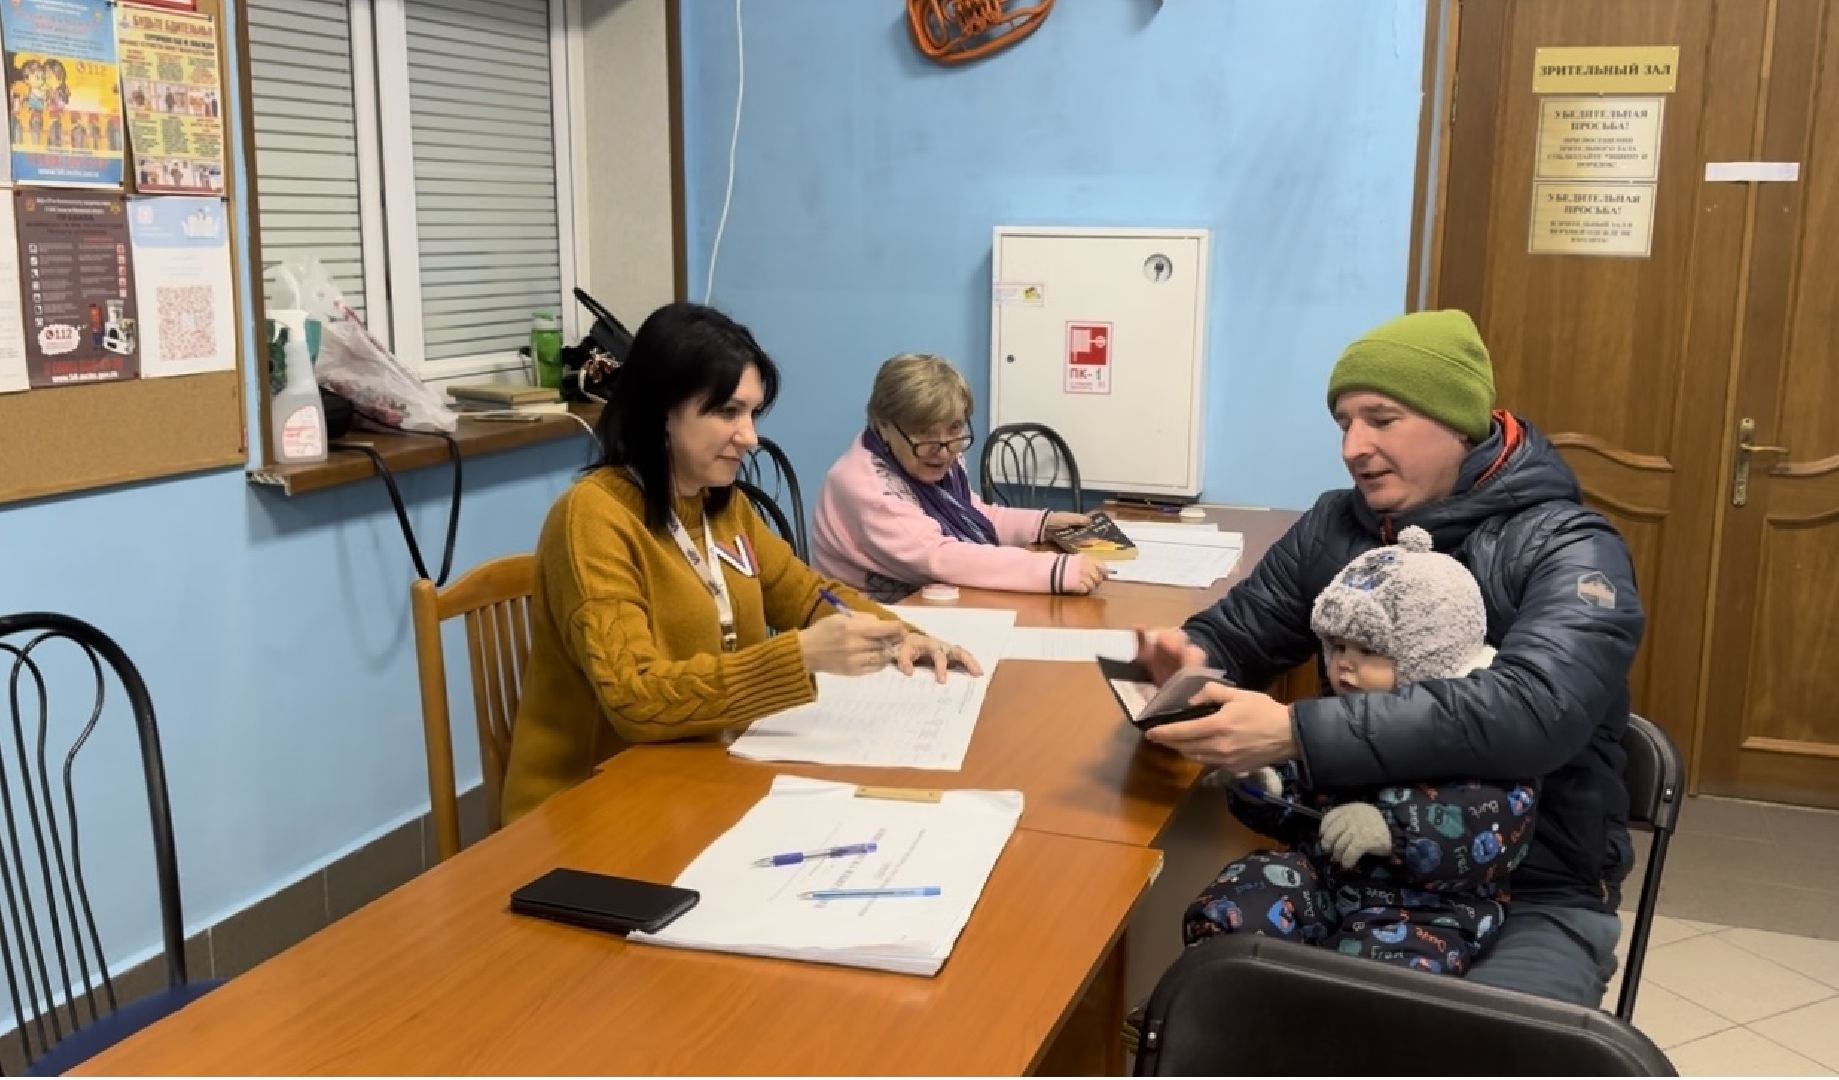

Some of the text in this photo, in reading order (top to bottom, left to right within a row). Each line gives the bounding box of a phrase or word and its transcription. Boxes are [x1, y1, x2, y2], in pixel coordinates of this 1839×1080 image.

[1539, 63, 1671, 76] ЗРИТЕЛЬНЫЙ ЗАЛ
[1554, 109, 1648, 119] УБЕДИТЕЛЬНАЯ
[1571, 121, 1629, 130] ПРОСЬБА!
[1547, 193, 1640, 203] УБЕДИТЕЛЬНАЯ
[1564, 206, 1622, 215] ПРОСЬБА!
[55, 328, 72, 340] 112
[1302, 890, 1315, 917] Dave
